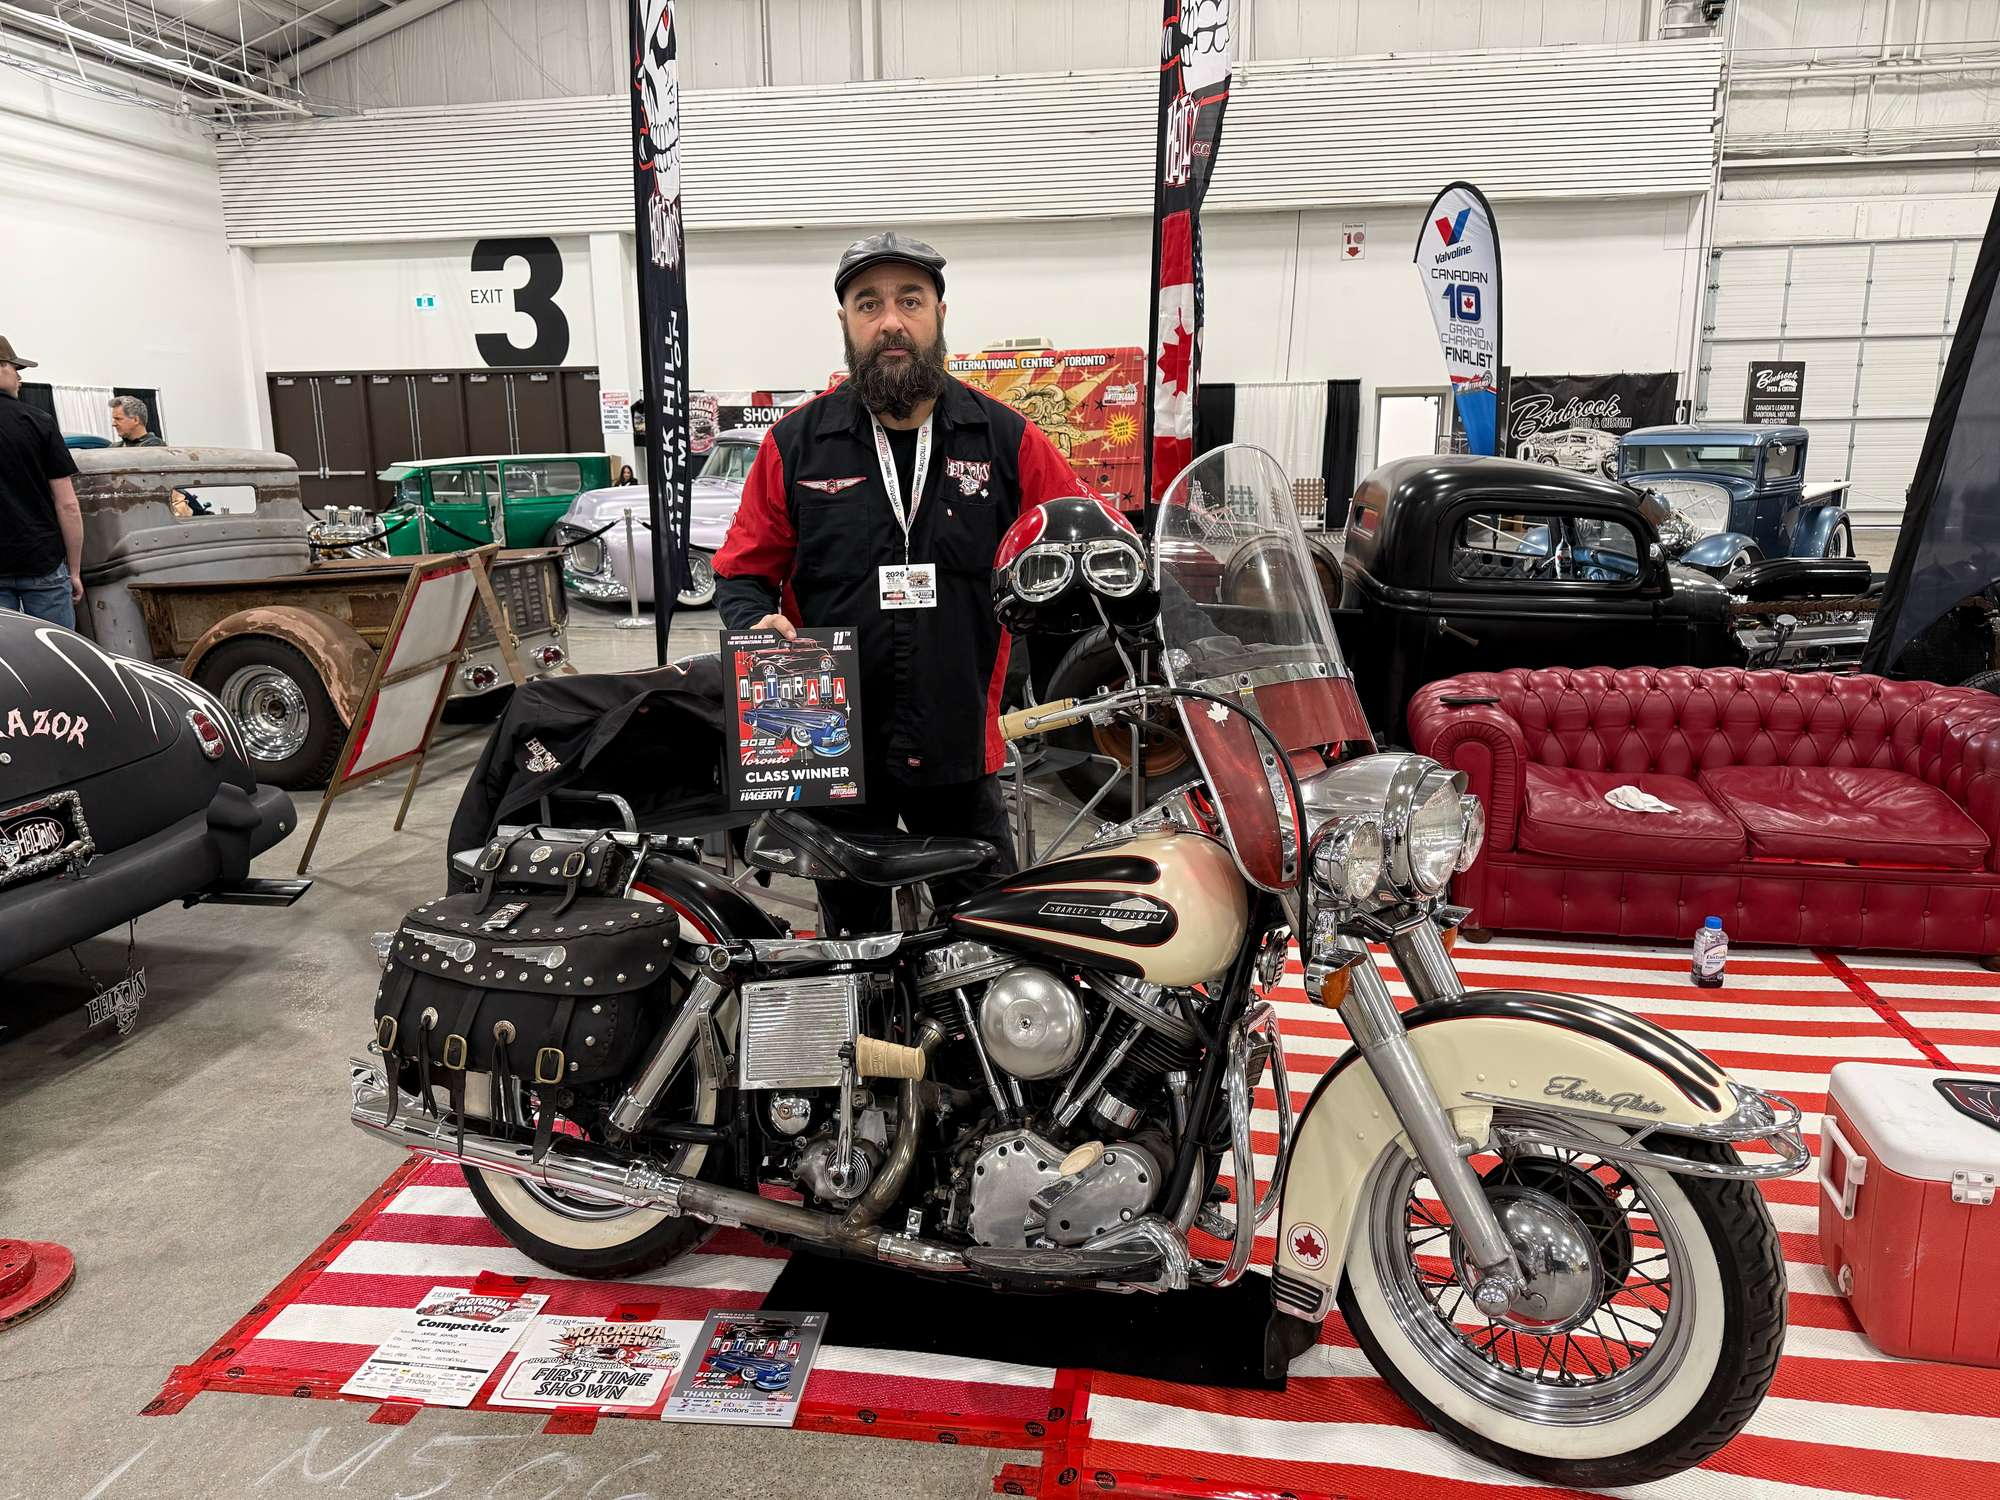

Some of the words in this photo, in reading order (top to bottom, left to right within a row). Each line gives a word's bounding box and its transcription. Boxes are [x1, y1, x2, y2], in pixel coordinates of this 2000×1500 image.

[1434, 245, 1473, 264] Valvoline
[1431, 268, 1489, 284] CANADIAN
[470, 289, 503, 303] EXIT
[470, 236, 570, 367] 3
[1441, 283, 1482, 324] 10
[1449, 323, 1485, 338] GRAND
[1441, 333, 1493, 352] CHAMPION
[948, 358, 1018, 371] INTERNATIONAL
[1020, 357, 1055, 369] CENTRE
[1063, 354, 1106, 367] TORONTO
[1445, 346, 1493, 369] FINALIST
[662, 322, 675, 417] HILL
[1756, 370, 1798, 389] Binbrook
[743, 408, 784, 422] SHOW
[1510, 394, 1621, 440] Binbrook
[1569, 417, 1592, 428] SPEED
[1592, 417, 1600, 428] &
[1601, 417, 1632, 428] CUSTOM
[740, 675, 844, 706] MOTORAMA
[0, 707, 89, 750] AZOR
[740, 738, 776, 747] 2026
[741, 750, 791, 766] Toronto
[745, 770, 789, 783] CLASS
[791, 766, 849, 780] WINNER
[740, 789, 785, 801] HAGERTY
[15, 820, 61, 858] HELLIONS
[1054, 905, 1089, 915] HARLEY
[1098, 910, 1153, 920] DAVIDSON
[1543, 1075, 1607, 1105] Electra
[1605, 1091, 1667, 1114] Glide
[453, 1306, 502, 1317] MAYHEM
[456, 1298, 511, 1311] MOTORAMA
[416, 1318, 510, 1334] Competitor
[563, 1324, 666, 1340] MOTORAMA
[574, 1334, 650, 1347] MAYHEM
[711, 1337, 799, 1355] MOTORAMA
[571, 1360, 600, 1368] CUSTOM
[600, 1361, 625, 1370] SHOW
[405, 1378, 437, 1387] motors
[411, 1371, 436, 1380] ebay
[531, 1367, 599, 1383] FIRST
[598, 1370, 653, 1387] TIME
[534, 1381, 628, 1400] SHOWN
[691, 1378, 733, 1390] Toronto
[682, 1390, 723, 1399] THANK
[723, 1391, 751, 1400] YOU!
